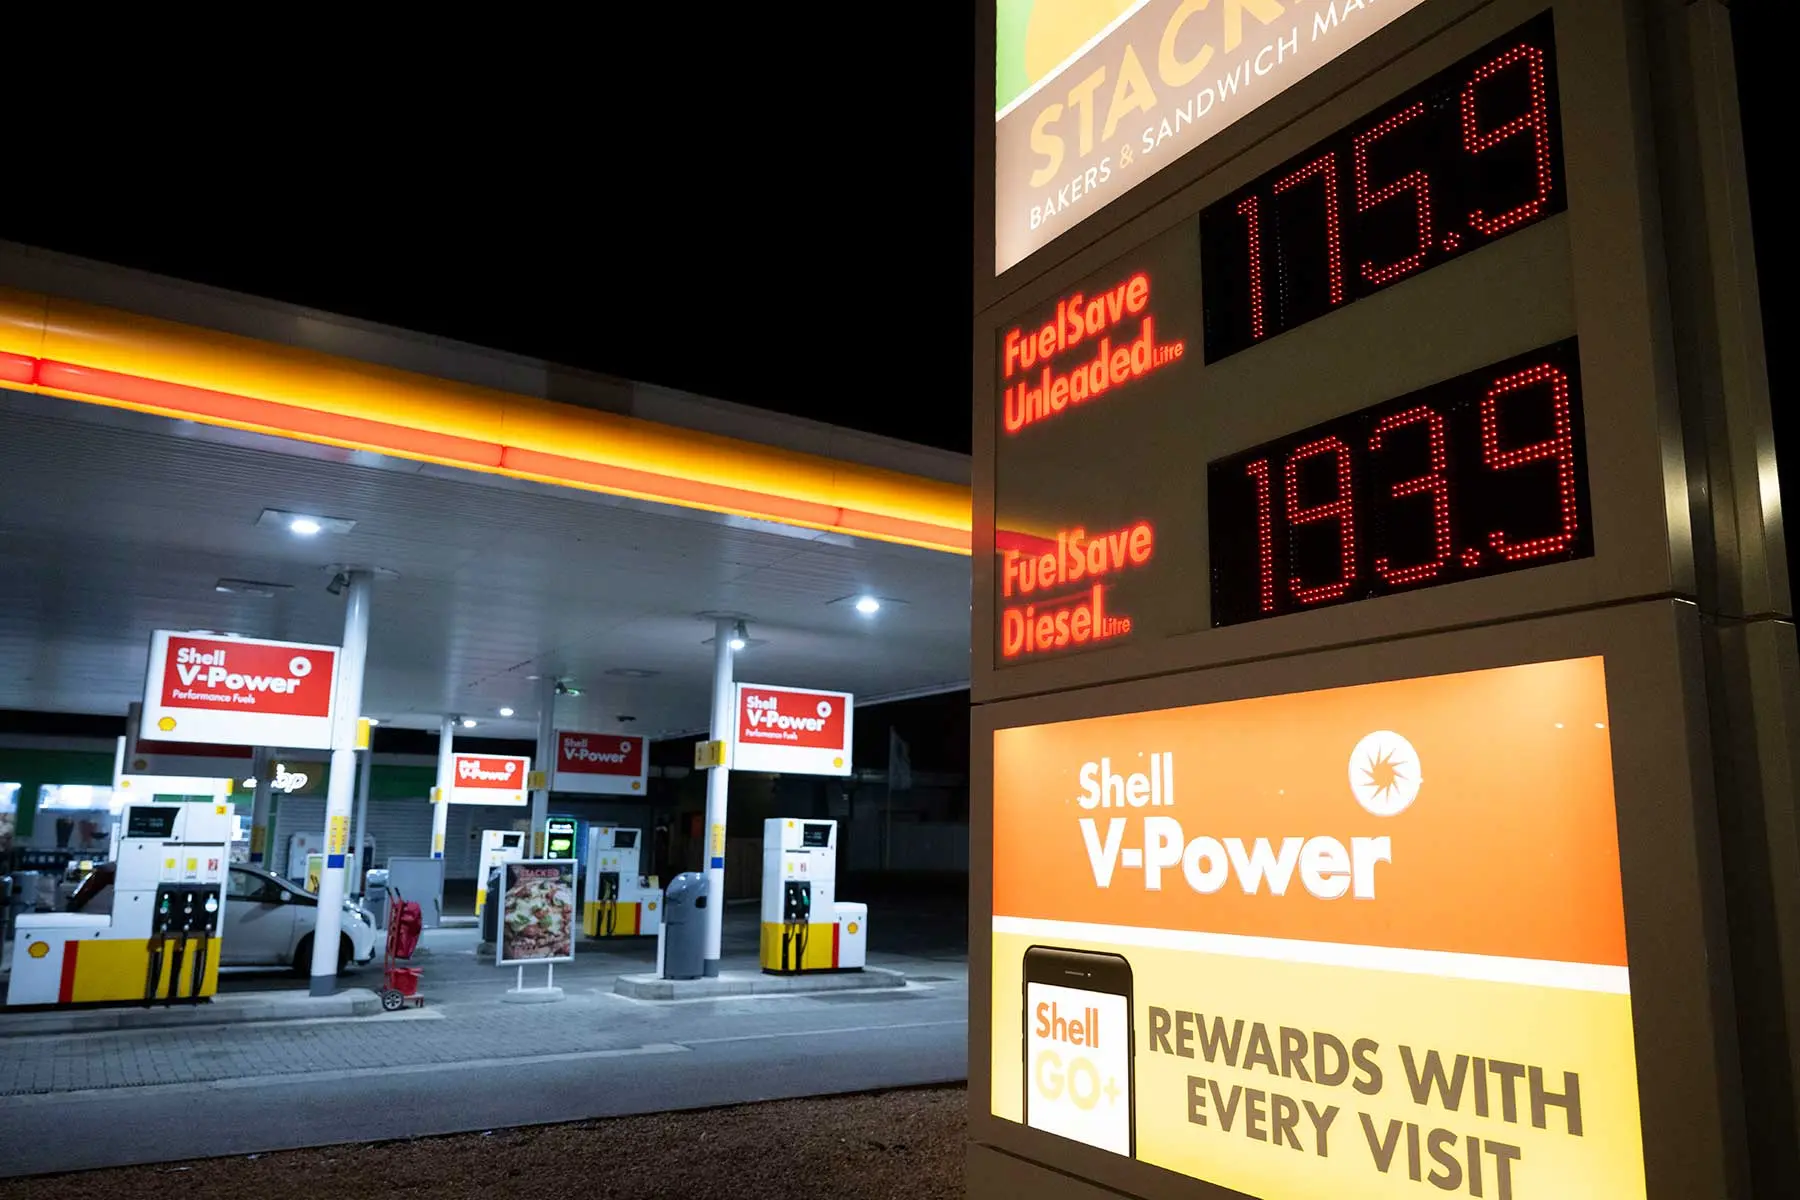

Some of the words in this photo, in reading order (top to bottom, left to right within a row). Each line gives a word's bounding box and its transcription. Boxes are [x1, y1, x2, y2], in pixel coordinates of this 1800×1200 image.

[1029, 0, 1303, 188] STACK
[1030, 157, 1112, 230] BAKERS
[1119, 143, 1135, 169] &
[1141, 26, 1298, 154] SANDWICH
[1311, 0, 1375, 42] MA
[1237, 44, 1552, 338] 175.9
[1004, 274, 1150, 377] FuelSave
[1004, 315, 1153, 432] Unleaded
[1152, 340, 1184, 368] Litre
[1003, 524, 1153, 598] FuelSave
[176, 647, 226, 666] Shell
[1002, 583, 1103, 657] Diesel
[1102, 617, 1132, 638] Litre
[172, 688, 231, 703] Performance
[232, 693, 256, 705] Fuels
[176, 663, 301, 694] V-Power
[746, 695, 777, 710] Shell
[563, 747, 627, 763] V-Power
[746, 708, 826, 732] V-Power
[1079, 752, 1174, 809] Shell
[1079, 816, 1393, 899] V-Power
[1036, 1001, 1099, 1048] Shell
[1149, 1005, 1383, 1095] REWARDS
[1398, 1044, 1584, 1137] WITH
[1187, 1075, 1339, 1158] EVERY
[1358, 1111, 1522, 1200] VISIT
